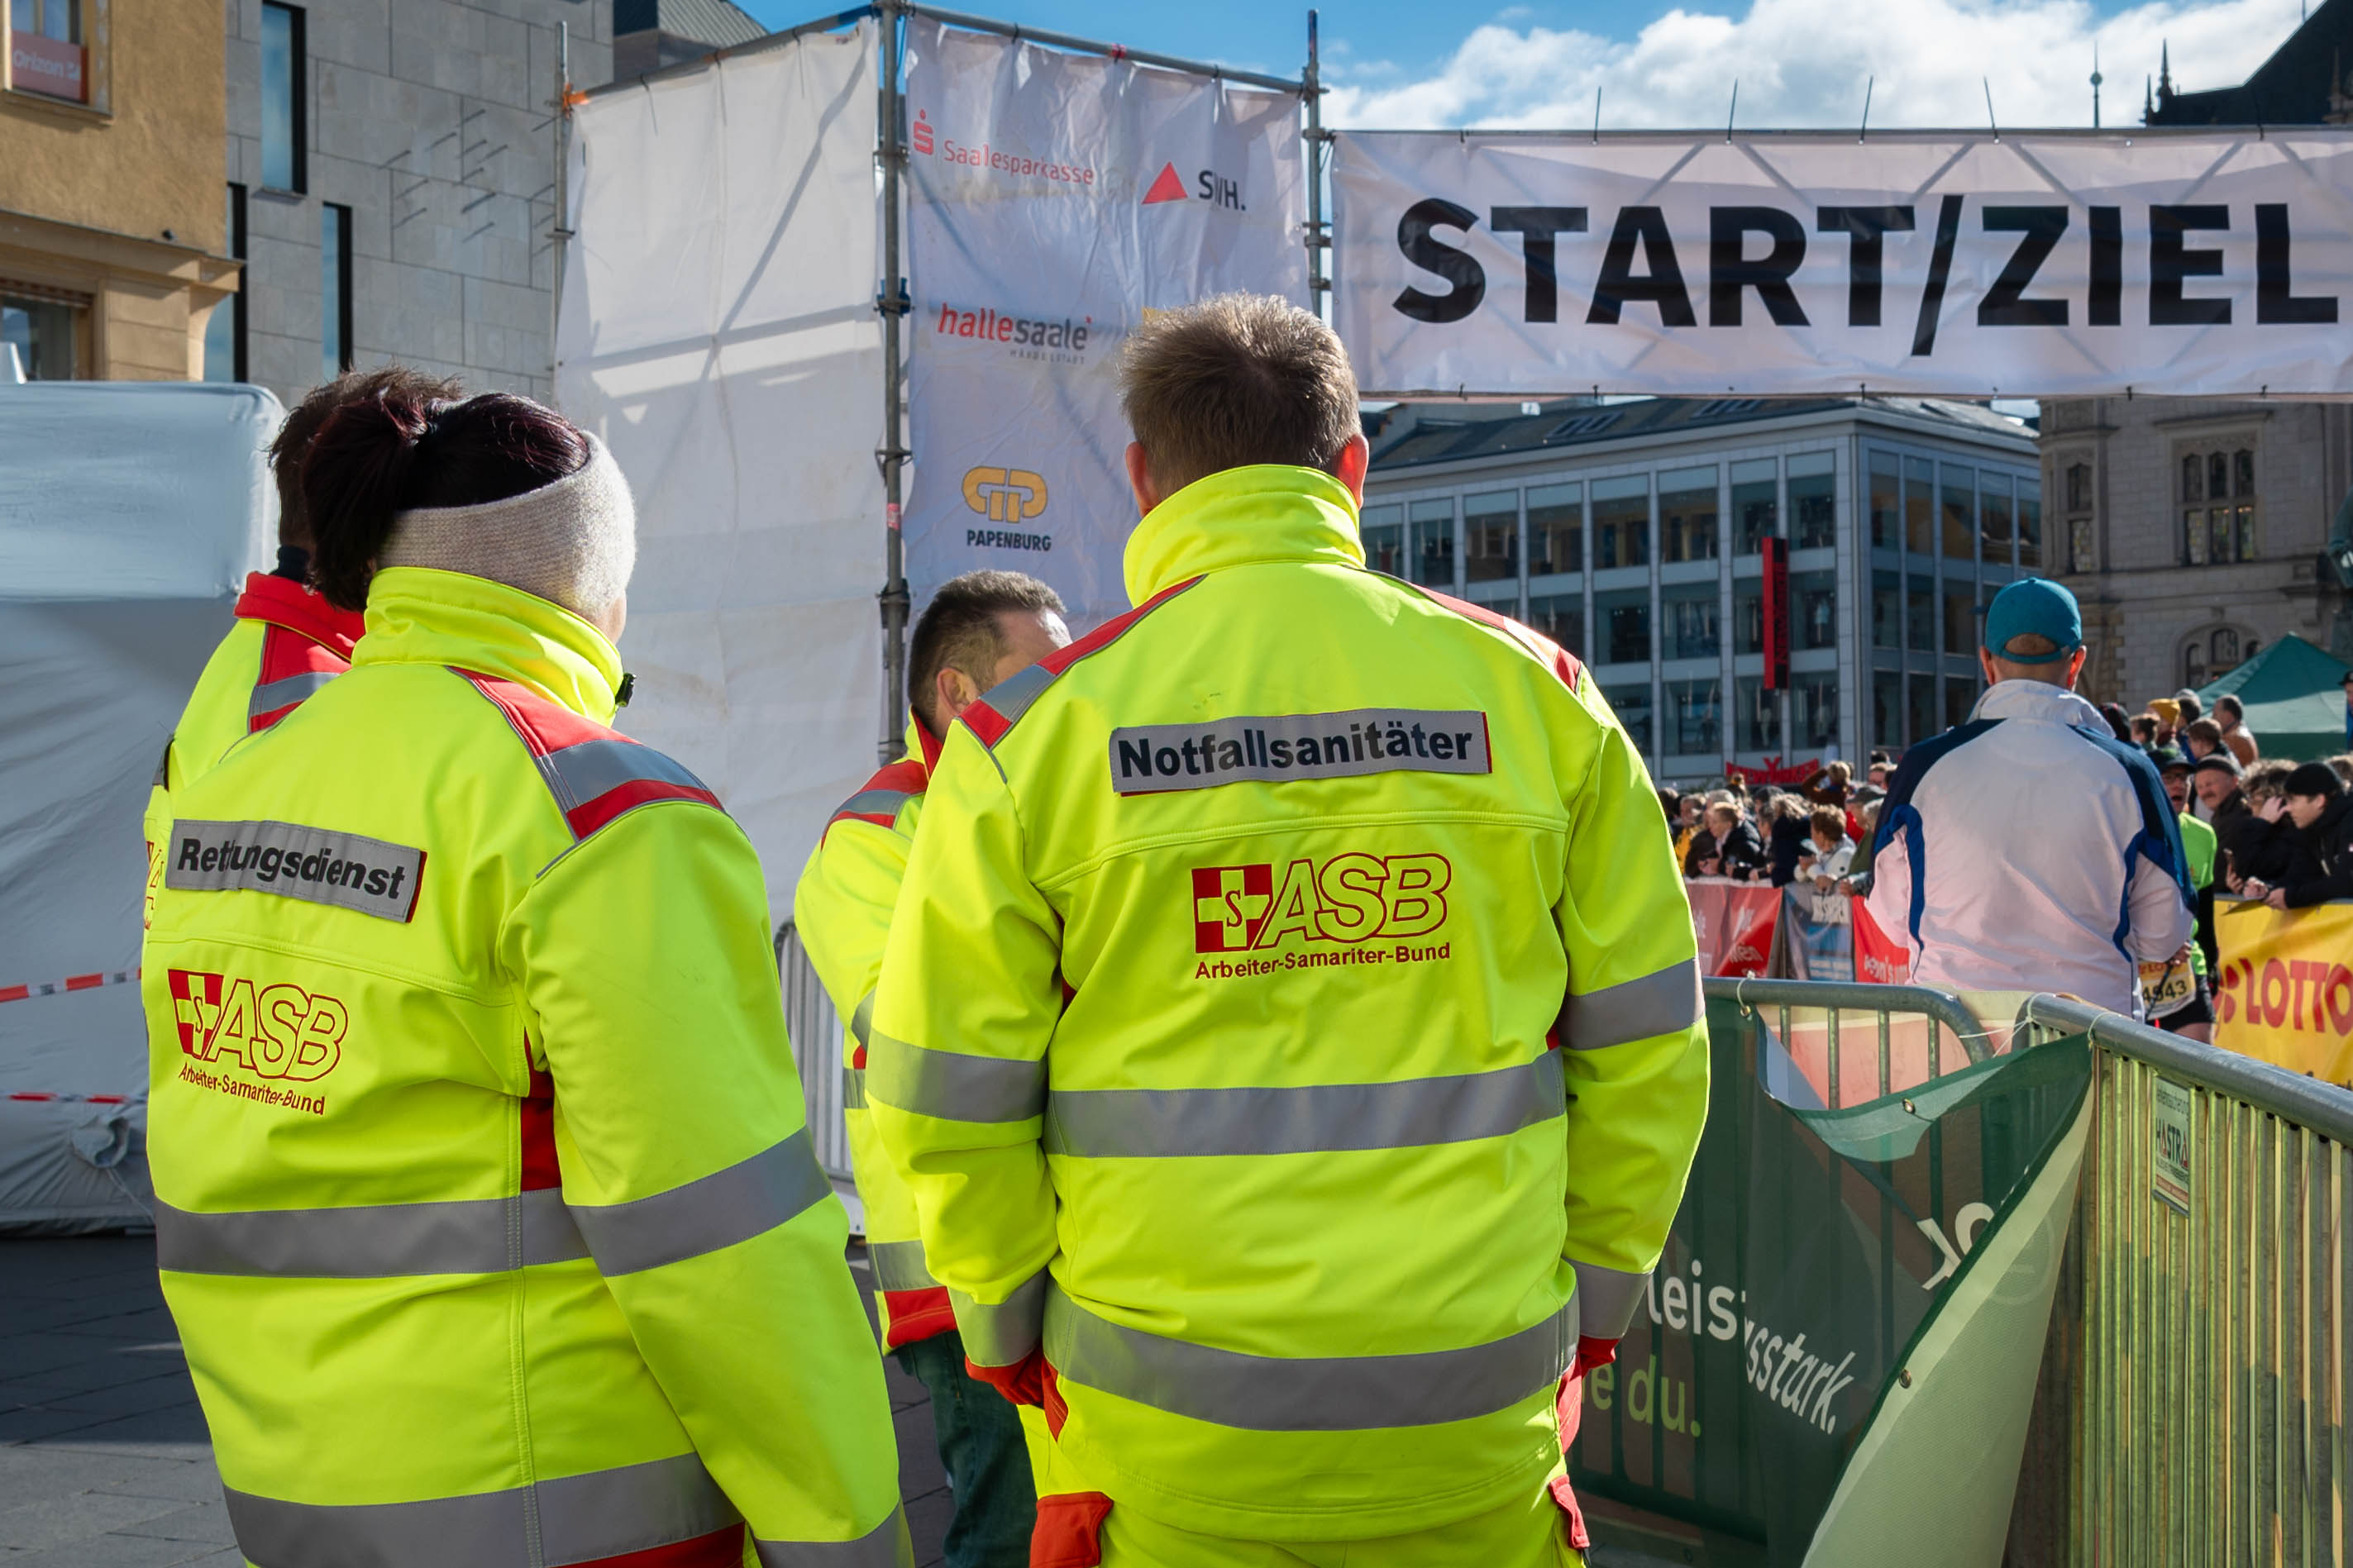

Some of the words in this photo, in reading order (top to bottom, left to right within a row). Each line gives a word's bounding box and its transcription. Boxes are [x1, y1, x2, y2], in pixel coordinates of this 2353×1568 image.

[943, 139, 1094, 185] Saalesparkasse
[1391, 193, 2339, 357] START/ZIEL
[966, 529, 1052, 551] PAPENBURG
[1118, 721, 1472, 778] Notfallsanitäter
[177, 837, 405, 899] Rettungsdienst
[1252, 852, 1451, 951] ASB
[1196, 942, 1451, 979] Arbeiter-Samariter-Bund
[2238, 957, 2353, 1037] LOTTO
[203, 978, 349, 1083] ASB
[178, 1062, 326, 1116] Arbeiter-Samariter-Bund
[1627, 1354, 1702, 1438] du.
